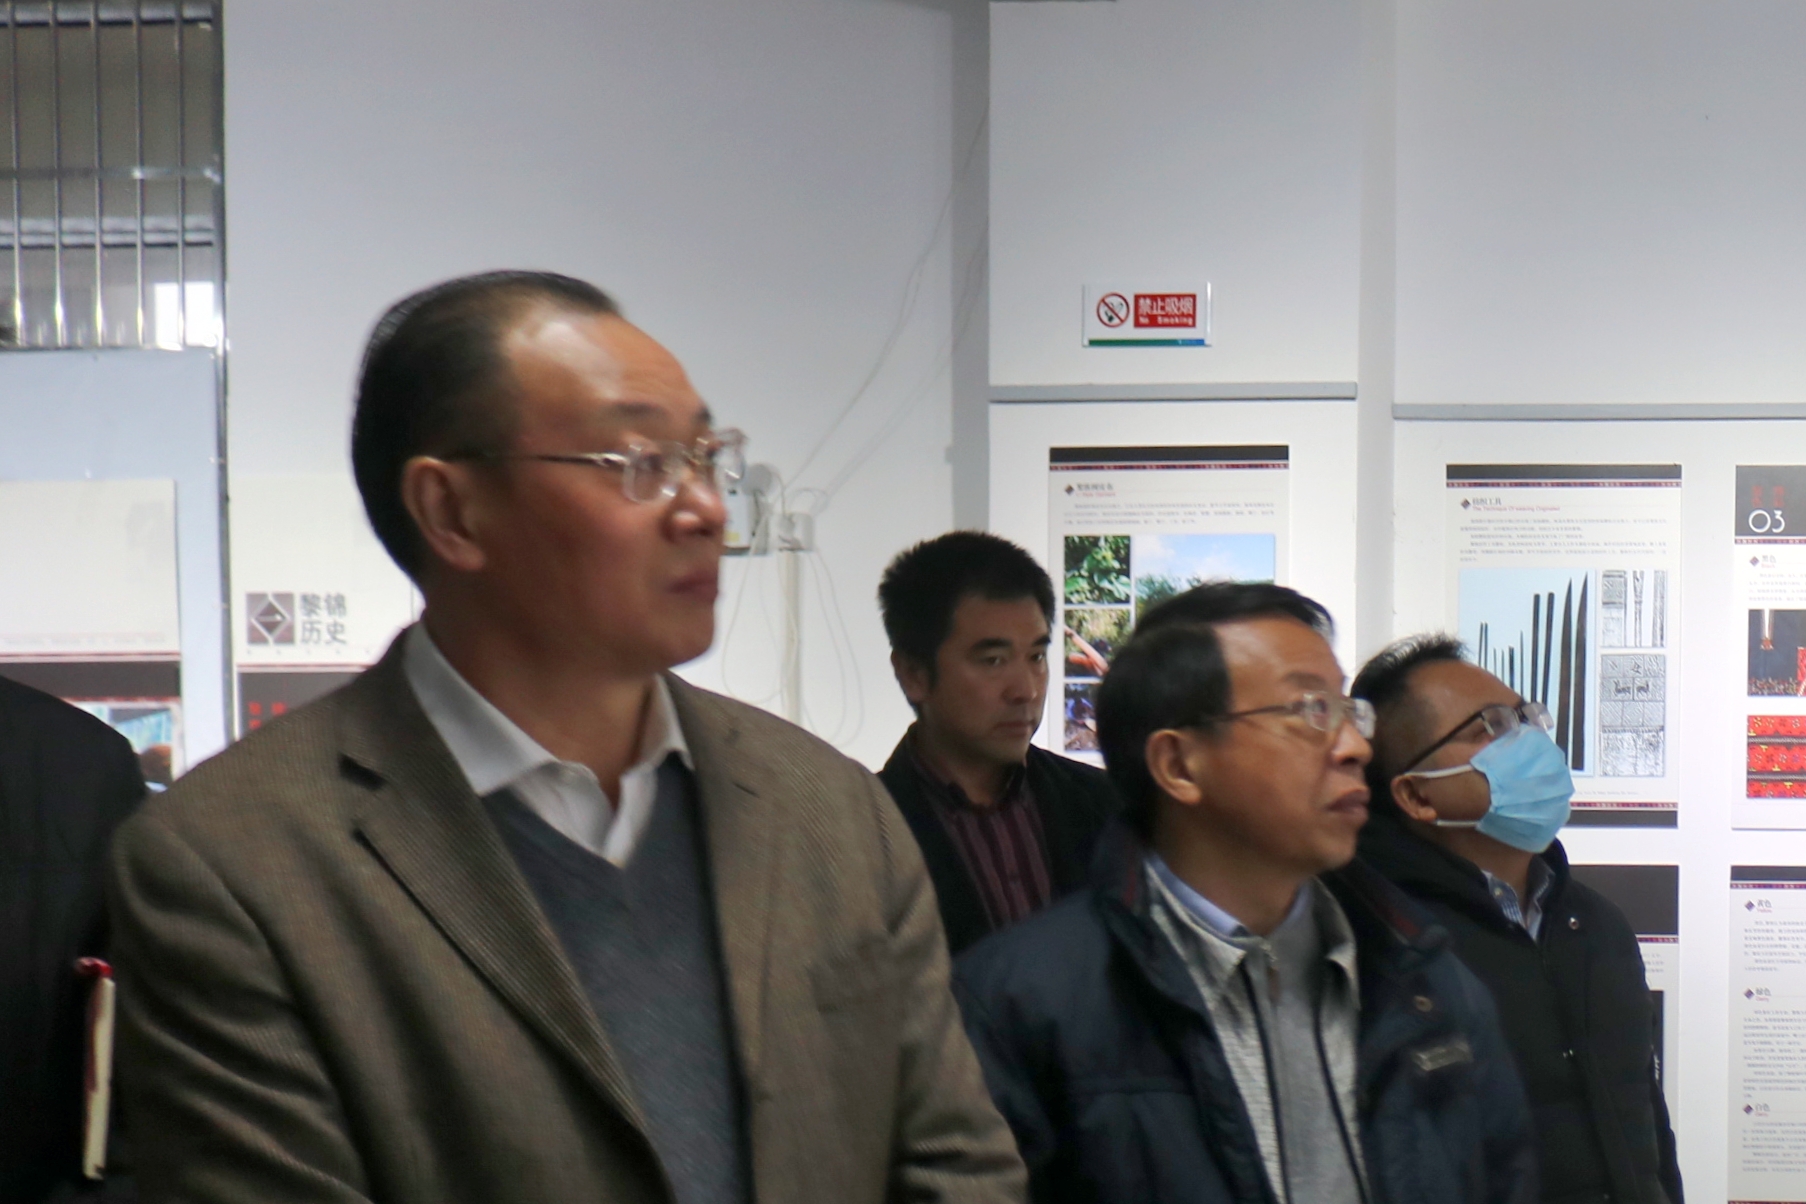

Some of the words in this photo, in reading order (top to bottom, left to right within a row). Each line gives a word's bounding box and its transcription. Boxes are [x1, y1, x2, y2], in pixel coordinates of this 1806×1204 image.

[1138, 296, 1194, 315] 禁止吸烟
[1139, 316, 1150, 325] No
[1157, 316, 1194, 326] Smoking
[1748, 509, 1786, 533] 03
[300, 594, 347, 618] 黎锦
[300, 619, 347, 644] 历史
